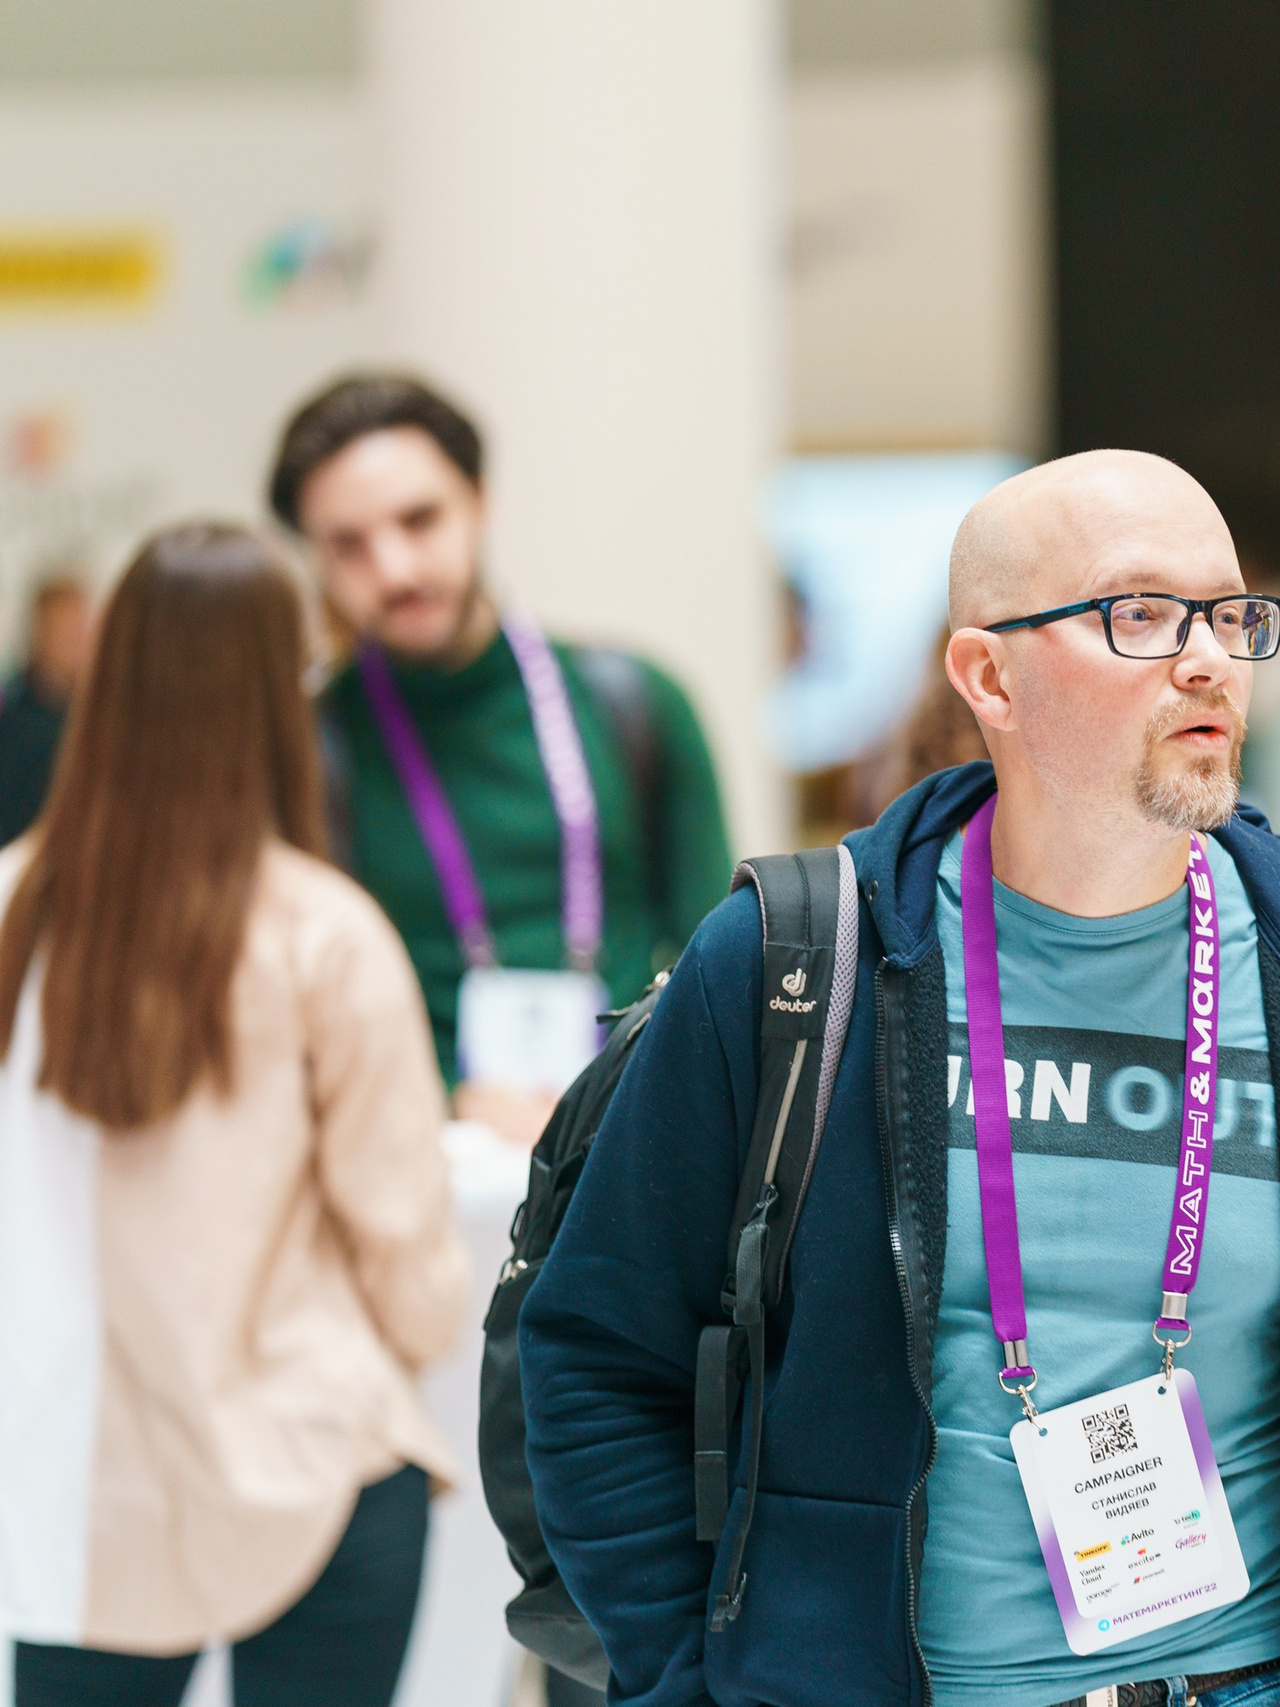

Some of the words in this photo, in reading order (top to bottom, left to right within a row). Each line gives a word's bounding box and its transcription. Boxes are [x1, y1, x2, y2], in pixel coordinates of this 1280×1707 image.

[769, 995, 817, 1013] deuter
[1170, 1111, 1209, 1276] MATH
[1190, 1071, 1210, 1105] &
[1074, 1456, 1163, 1494] CAMPAIGNER
[1091, 1482, 1157, 1510] СТАНИСЛАВ
[1105, 1498, 1150, 1519] ВИДЯЕВ
[1131, 1529, 1155, 1542] Avito
[1112, 1582, 1218, 1626] МАТЕМАРКЕТИНГ22
